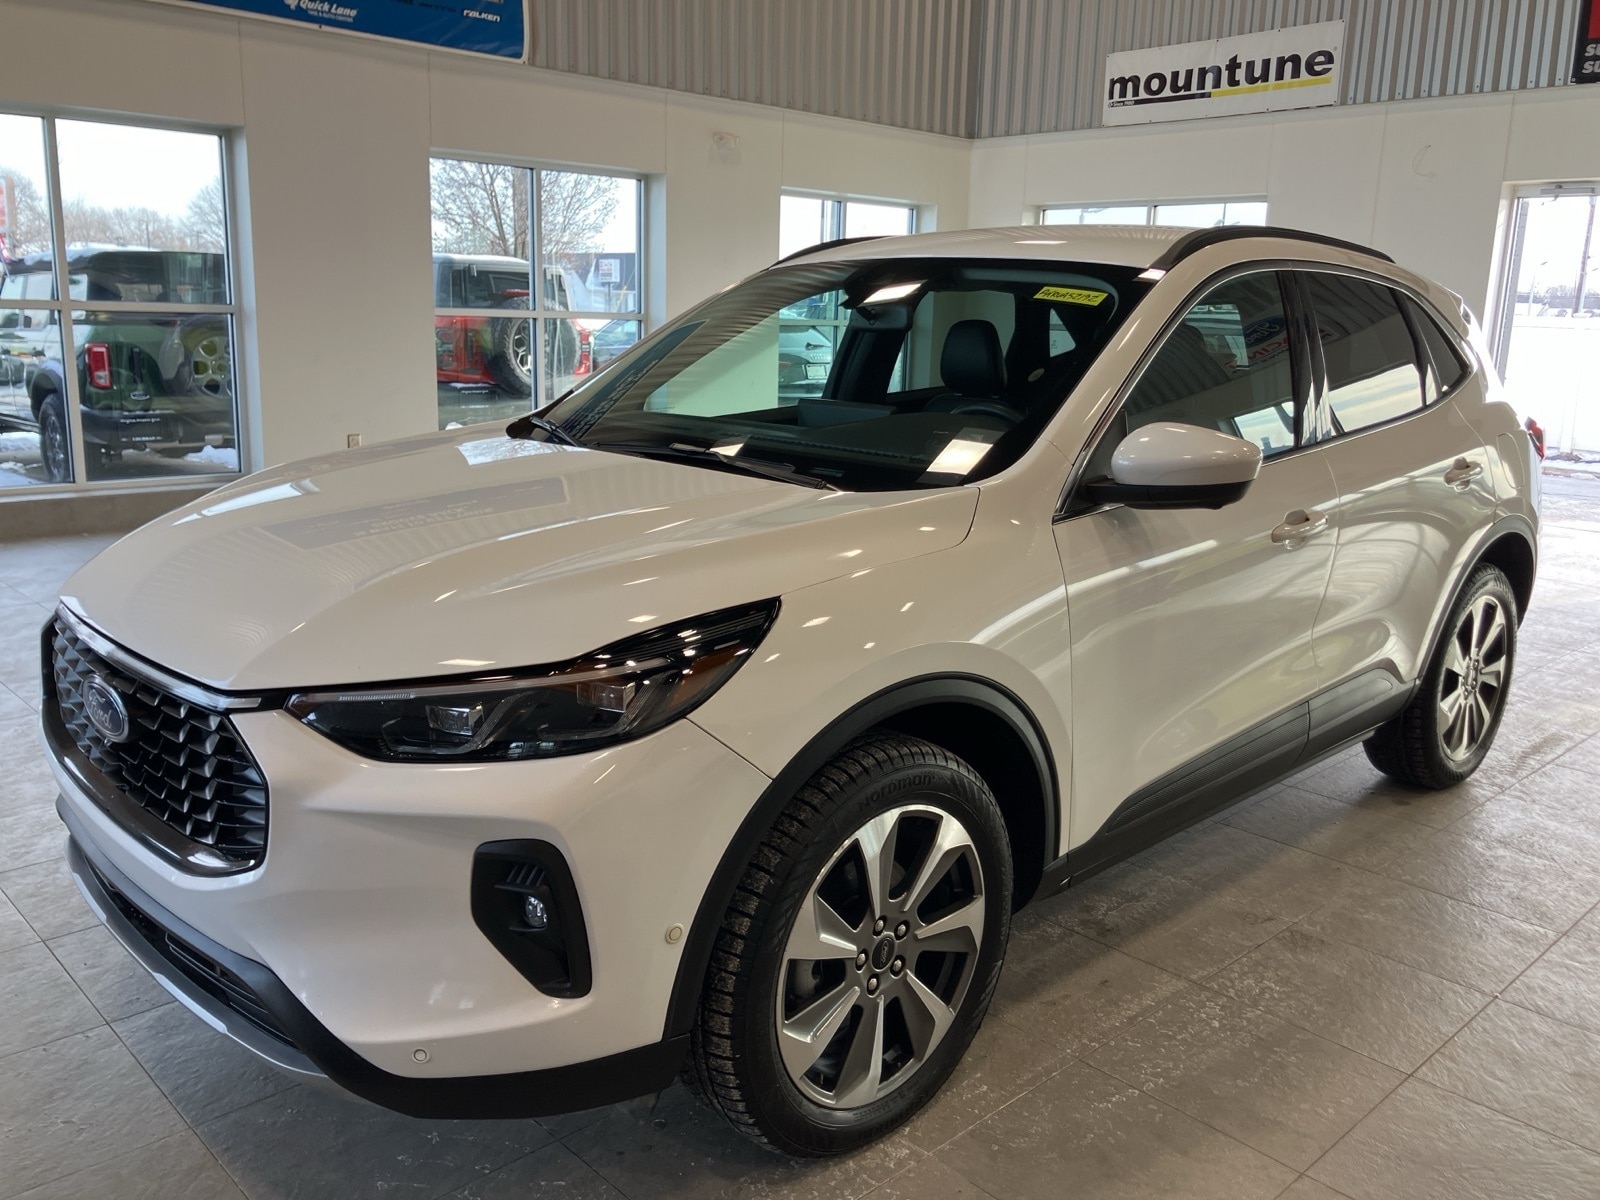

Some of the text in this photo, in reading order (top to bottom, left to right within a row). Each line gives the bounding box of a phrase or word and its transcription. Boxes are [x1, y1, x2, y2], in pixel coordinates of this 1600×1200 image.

[300, 0, 330, 12] Quick
[331, 3, 358, 17] Lane
[1108, 49, 1335, 100] mountune
[88, 688, 112, 729] Ford
